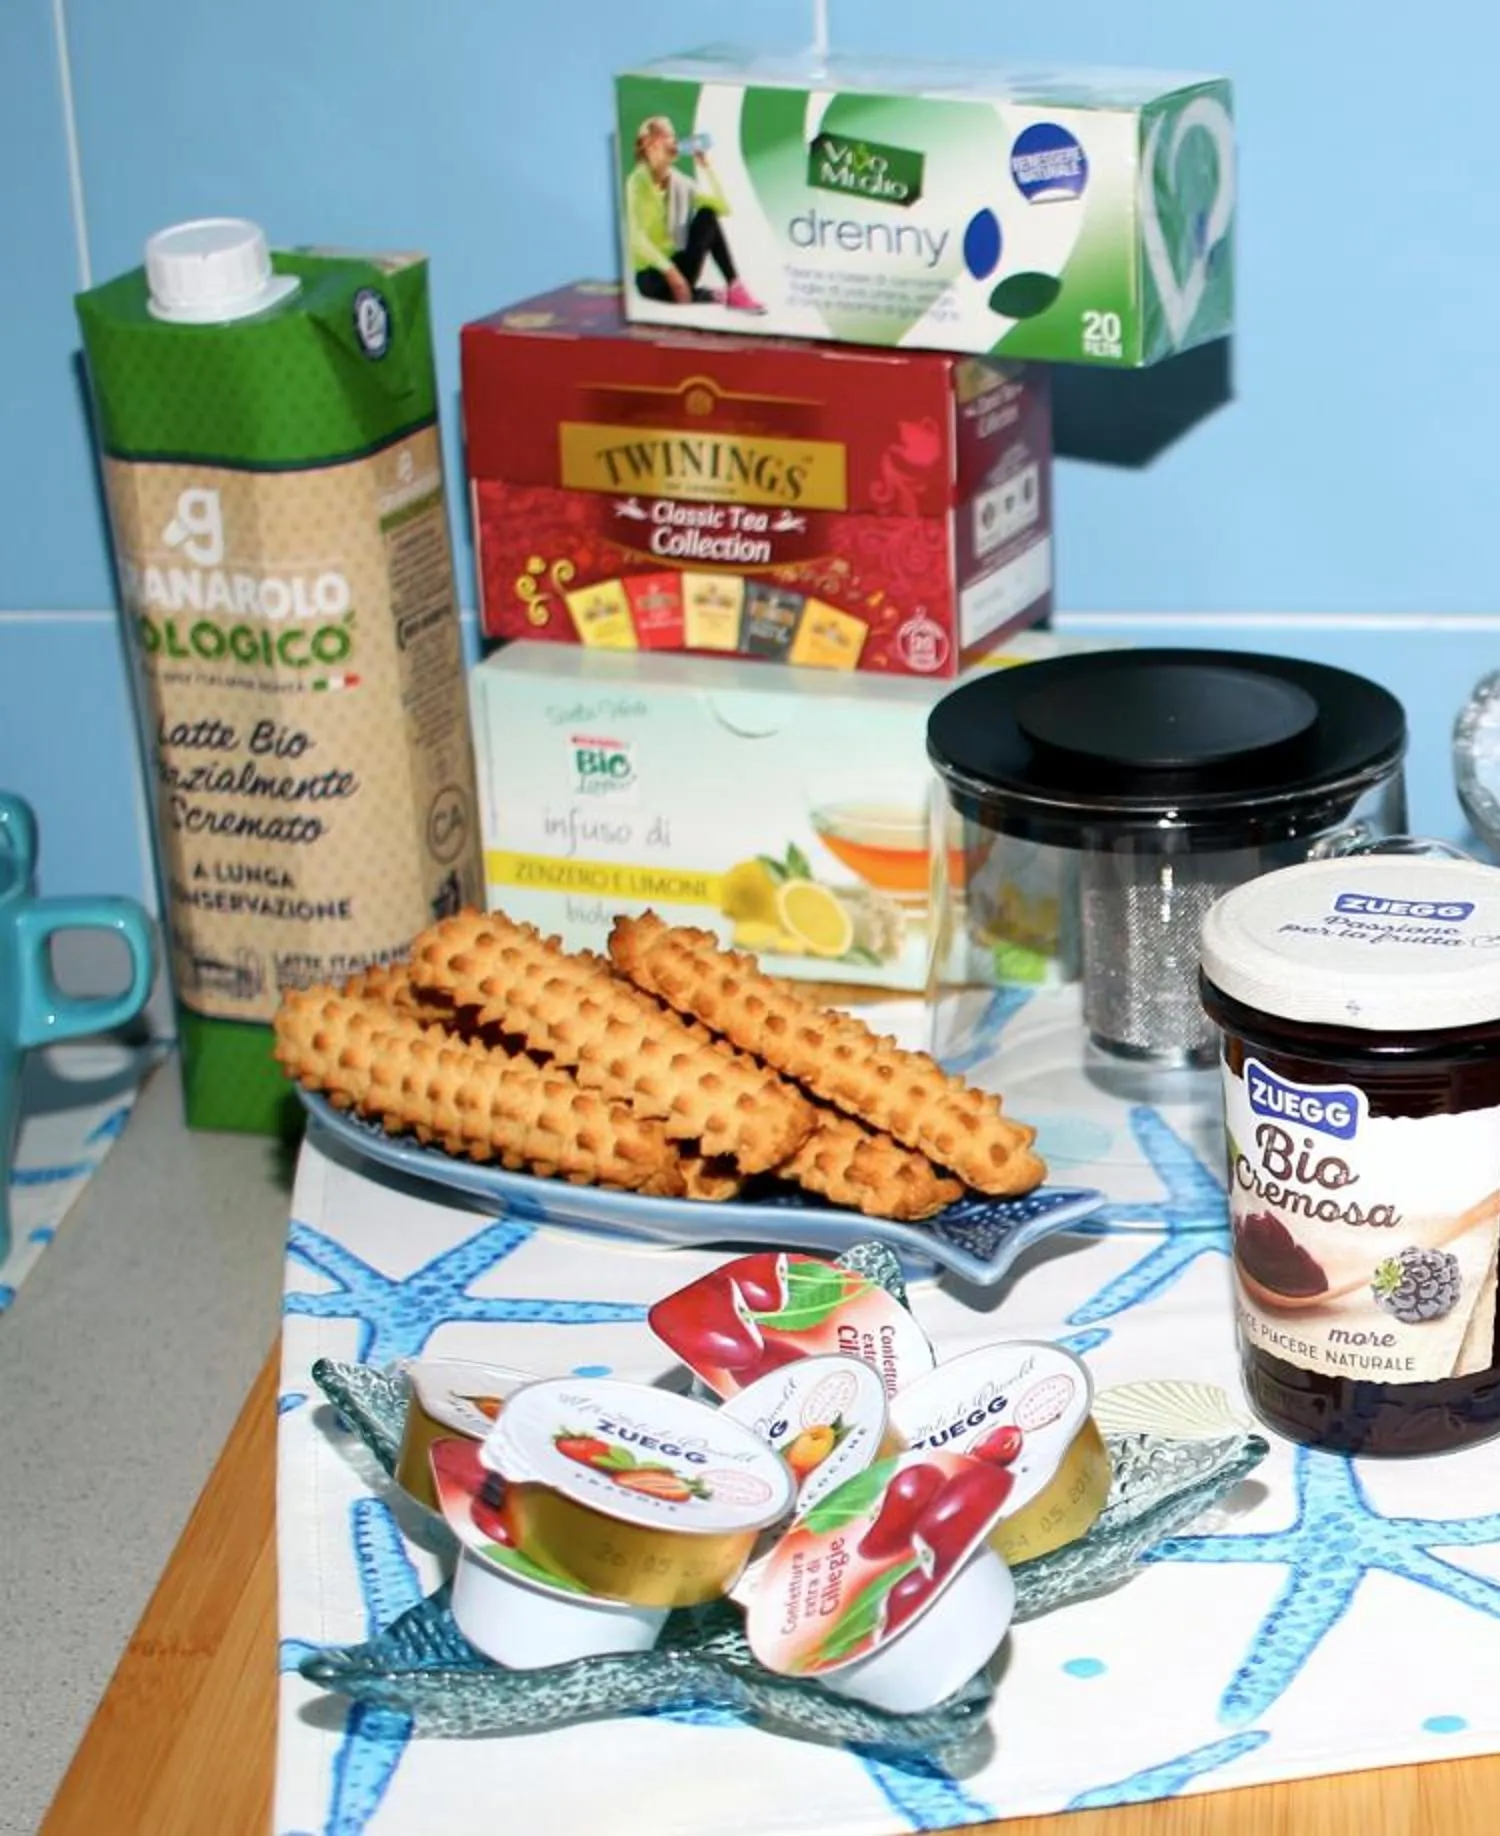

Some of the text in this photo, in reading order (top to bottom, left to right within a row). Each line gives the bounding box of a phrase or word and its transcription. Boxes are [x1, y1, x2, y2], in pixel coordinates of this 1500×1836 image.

[787, 208, 951, 267] drenny
[1081, 310, 1121, 341] 20
[597, 440, 806, 500] TWININGS
[652, 500, 769, 532] Classic Tea
[651, 527, 771, 563] Collection
[138, 567, 350, 619] ANAROLO
[250, 717, 317, 759] Bio
[545, 807, 671, 858] infuso di
[192, 863, 295, 888] A LUNGA
[515, 862, 609, 887] ZENZERO
[630, 875, 708, 897] LIMONE
[1324, 914, 1460, 935] Passione
[1340, 897, 1465, 918] ZUEGG
[1277, 923, 1466, 947] per la frutta
[1251, 1078, 1351, 1128] ZUEGG
[1255, 1123, 1360, 1190] Bio
[1235, 1153, 1403, 1229] Cremosa
[1261, 1323, 1320, 1360] PIACERE
[1325, 1350, 1417, 1371] NATURALE
[1328, 1327, 1398, 1347] more
[597, 1419, 708, 1464] ZUEGG
